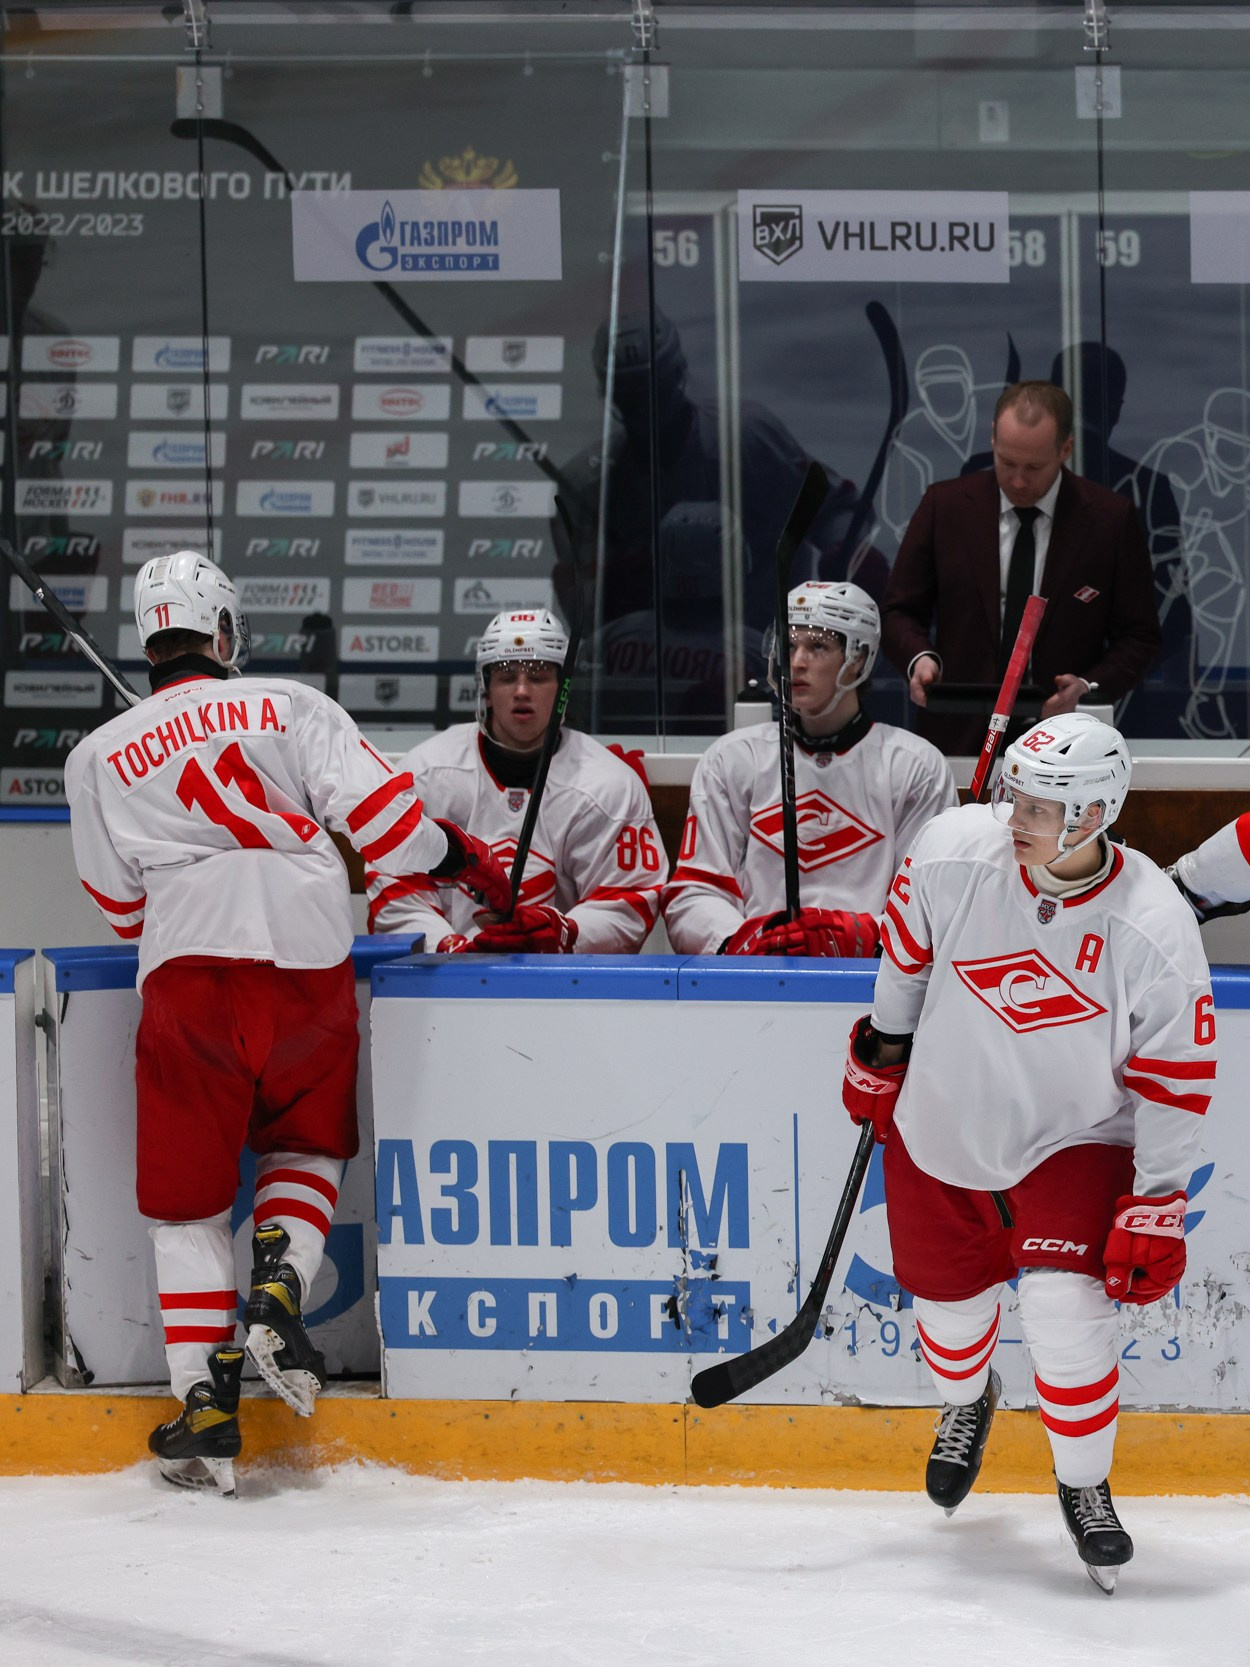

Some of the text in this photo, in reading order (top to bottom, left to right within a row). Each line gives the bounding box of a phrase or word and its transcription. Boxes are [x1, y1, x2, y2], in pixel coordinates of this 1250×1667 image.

[36, 171, 250, 199] ШЕЛКОВОГО
[263, 172, 353, 199] ПУТИ
[1, 214, 144, 235] 2022/2023
[400, 220, 499, 247] ГАЗПРОМ
[817, 220, 995, 252] VHLRU.RU
[656, 231, 699, 267] 56
[1096, 230, 1140, 267] 59
[404, 255, 496, 269] ЭКСПОРТ
[255, 345, 330, 364] PARI
[29, 441, 103, 460] PARI
[251, 440, 326, 460] PARI
[473, 442, 548, 461] PARI
[24, 536, 99, 556] PARI
[246, 538, 320, 557] PARI
[468, 539, 543, 558] PARI
[155, 603, 170, 629] 11
[107, 697, 286, 788] TOCHILKIN A.
[1022, 730, 1056, 754] 62
[175, 741, 320, 849] 11
[616, 826, 659, 871] 86
[1075, 933, 1105, 974] A
[1022, 1238, 1089, 1257] CCM
